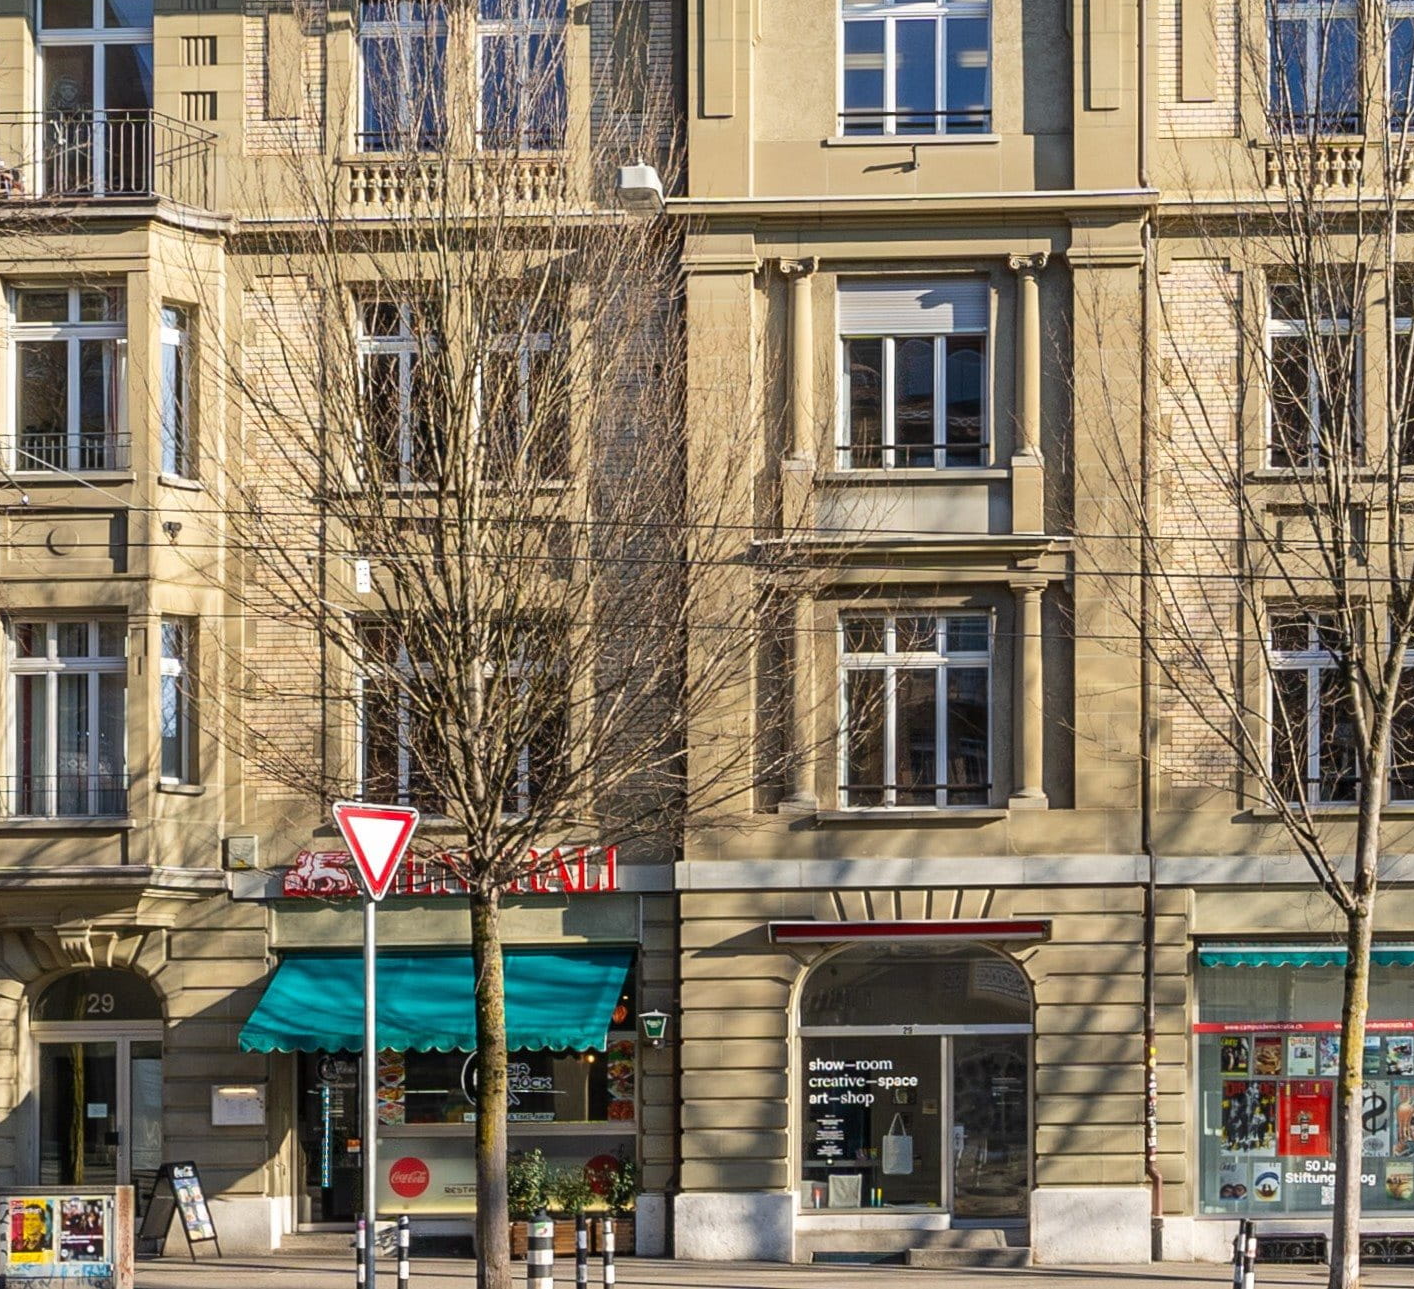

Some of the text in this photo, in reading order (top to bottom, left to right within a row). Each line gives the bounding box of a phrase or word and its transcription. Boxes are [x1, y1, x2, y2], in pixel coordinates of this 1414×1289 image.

[87, 993, 115, 1014] 29
[1305, 1160, 1321, 1172] 50
[1285, 1172, 1337, 1186] Stiftung
